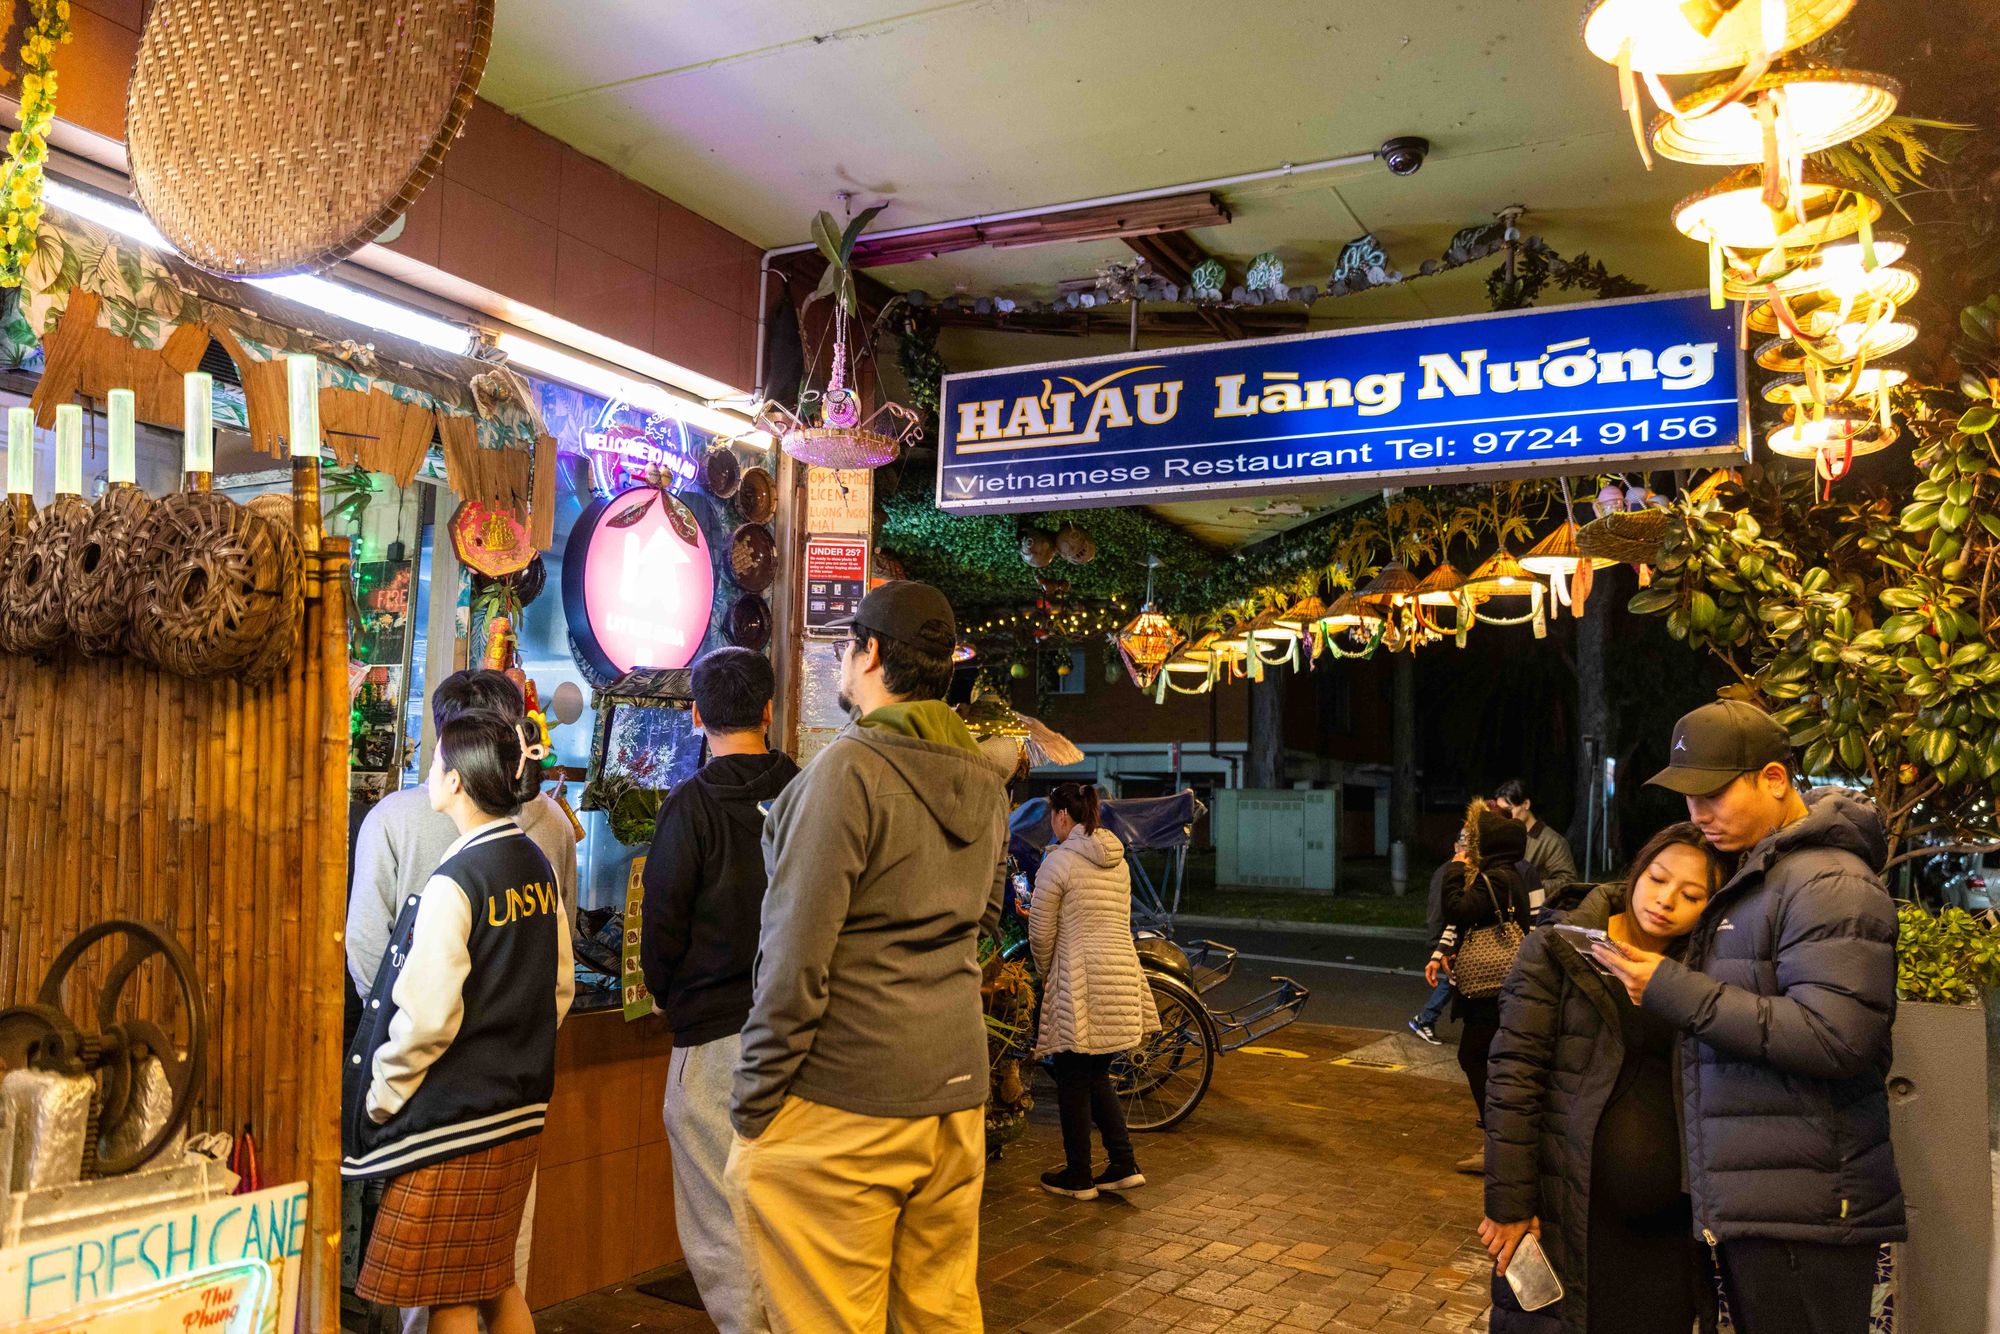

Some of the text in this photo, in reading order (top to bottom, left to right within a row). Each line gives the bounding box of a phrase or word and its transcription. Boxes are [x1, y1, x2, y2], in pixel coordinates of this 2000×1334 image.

[954, 415, 1718, 494] Vietnamese Restaurant Tel: 9724 9156
[809, 471, 825, 484] ON
[810, 488, 858, 502] LICENE
[809, 506, 842, 518] LUONG
[810, 519, 835, 532] MAI
[810, 547, 862, 557] UNDER 25?
[488, 880, 557, 927] UNSW
[24, 1191, 309, 1318] FRESH CANE
